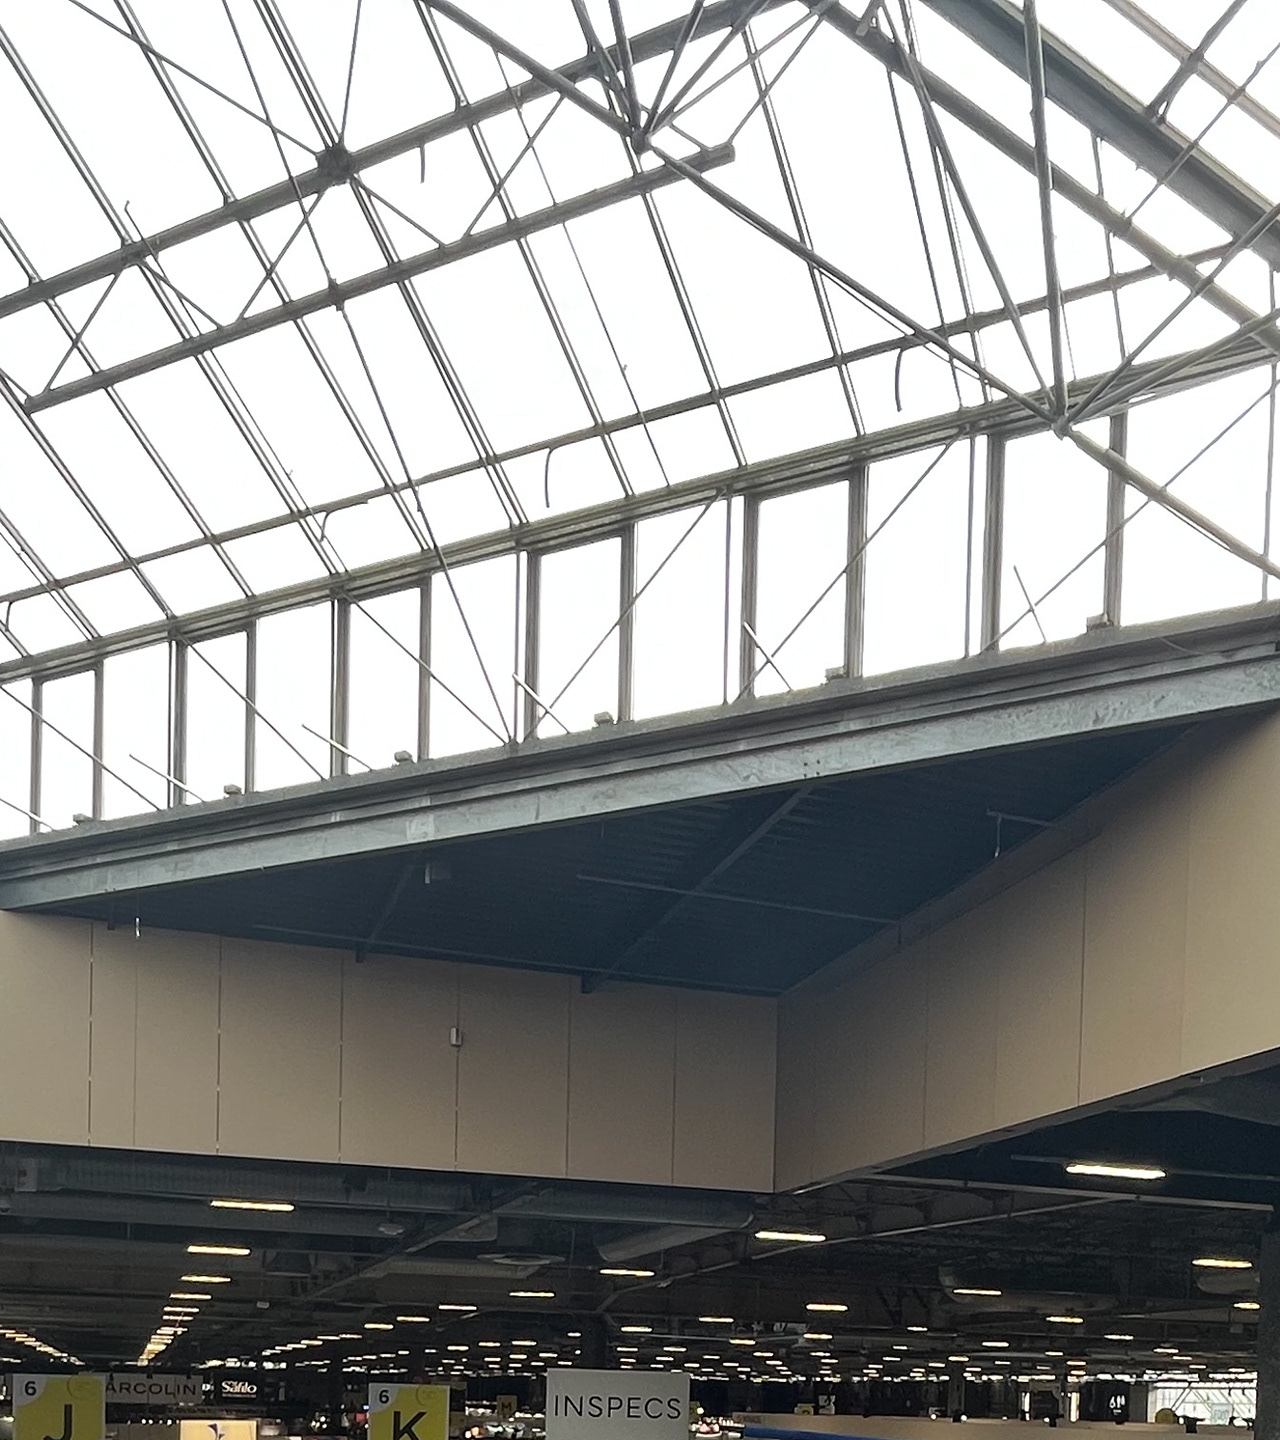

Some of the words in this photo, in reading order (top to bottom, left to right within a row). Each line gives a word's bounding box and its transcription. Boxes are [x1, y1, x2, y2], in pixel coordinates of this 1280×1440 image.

[23, 1381, 38, 1396] 6
[105, 1381, 197, 1398] ARCOLIN
[378, 1389, 390, 1404] 6
[553, 1394, 682, 1420] INSPECS
